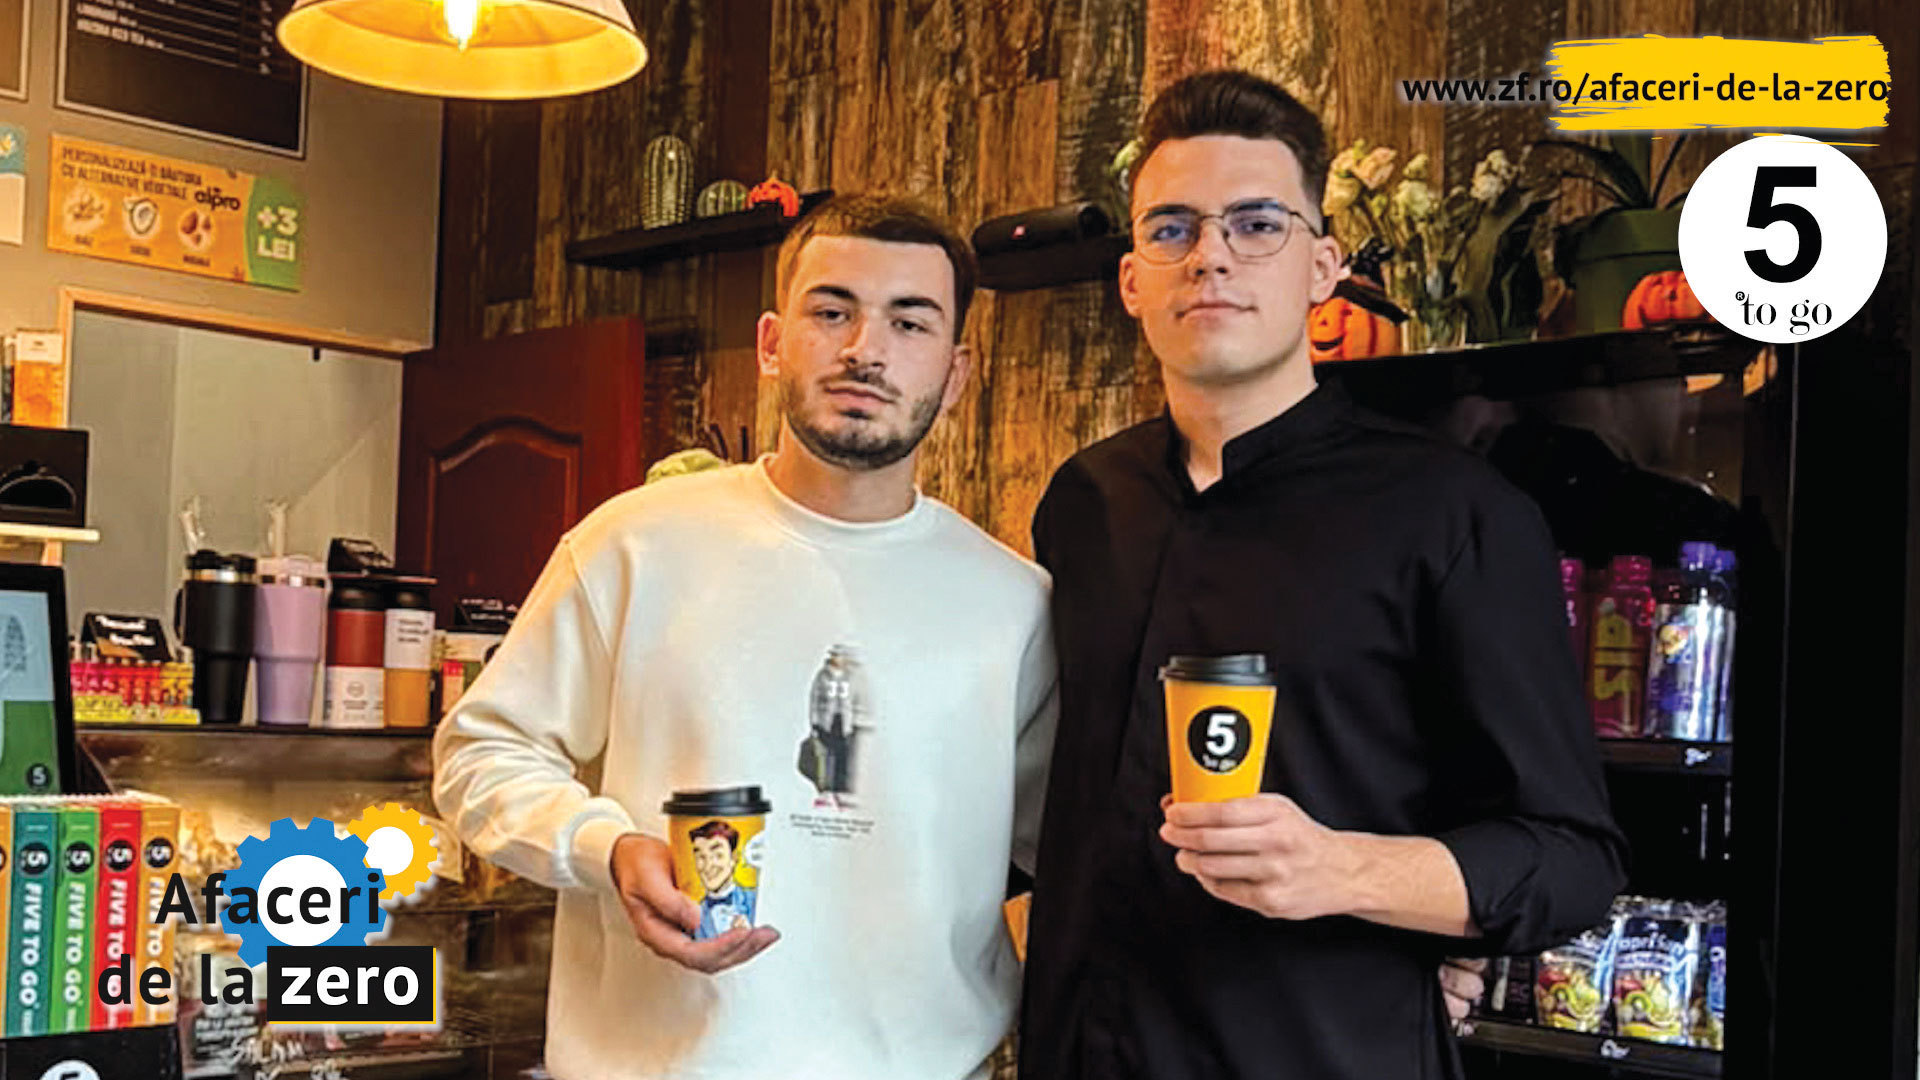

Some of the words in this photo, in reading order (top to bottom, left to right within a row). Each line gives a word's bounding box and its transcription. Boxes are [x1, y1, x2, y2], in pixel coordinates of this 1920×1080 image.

[194, 187, 241, 211] alpro
[257, 205, 298, 236] +3
[257, 235, 296, 262] LEI
[1205, 713, 1237, 757] 5
[27, 851, 48, 868] 5
[71, 851, 91, 867] 5
[113, 848, 133, 865] 5
[23, 881, 44, 931] FIVE
[67, 881, 87, 930] FIVE
[108, 878, 129, 926] FIVE
[21, 935, 40, 965] TO
[65, 934, 84, 964] TO
[106, 930, 125, 961] TO
[147, 928, 163, 957] TO
[19, 970, 39, 1007] GO
[63, 967, 82, 1003] GO
